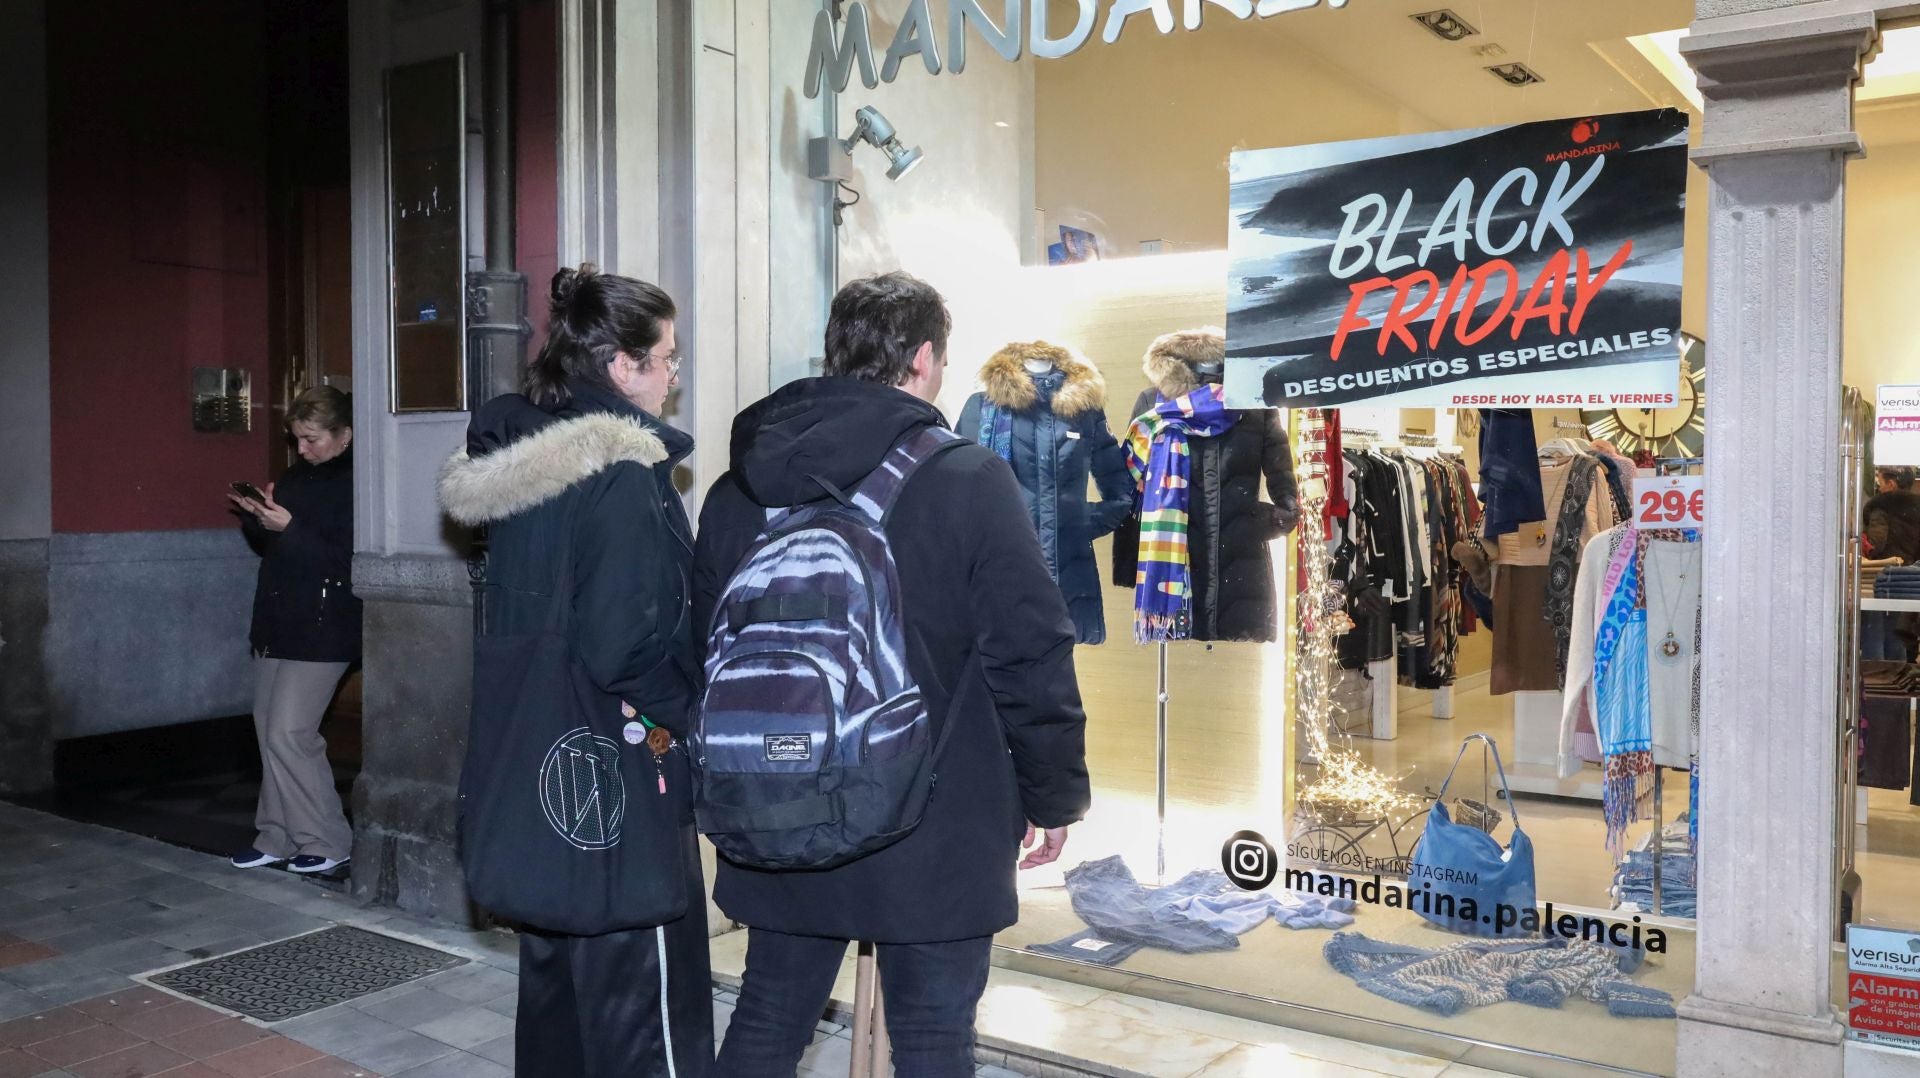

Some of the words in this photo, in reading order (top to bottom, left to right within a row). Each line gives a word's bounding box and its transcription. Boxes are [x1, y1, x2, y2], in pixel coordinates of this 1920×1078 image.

[1545, 142, 1621, 162] MANDARINA
[1328, 154, 1606, 279] BLACK
[1329, 240, 1634, 361] FRIDAY
[1284, 355, 1469, 398] DESCUENTOS
[1479, 327, 1672, 371] ESPECIALES
[1452, 395, 1497, 405] DESDE
[1501, 395, 1531, 404] HOY
[1535, 394, 1583, 404] HASTA
[1588, 394, 1605, 404] EL
[1609, 393, 1674, 403] VIERNES
[1639, 489, 1704, 523] 29€
[1618, 529, 1637, 558] LOV
[1365, 856, 1385, 871] EN
[1389, 860, 1478, 886] INSTAGRAM
[1285, 867, 1668, 954] mandarina.palencia
[1855, 1014, 1884, 1026] Aviso
[1870, 1004, 1883, 1013] de
